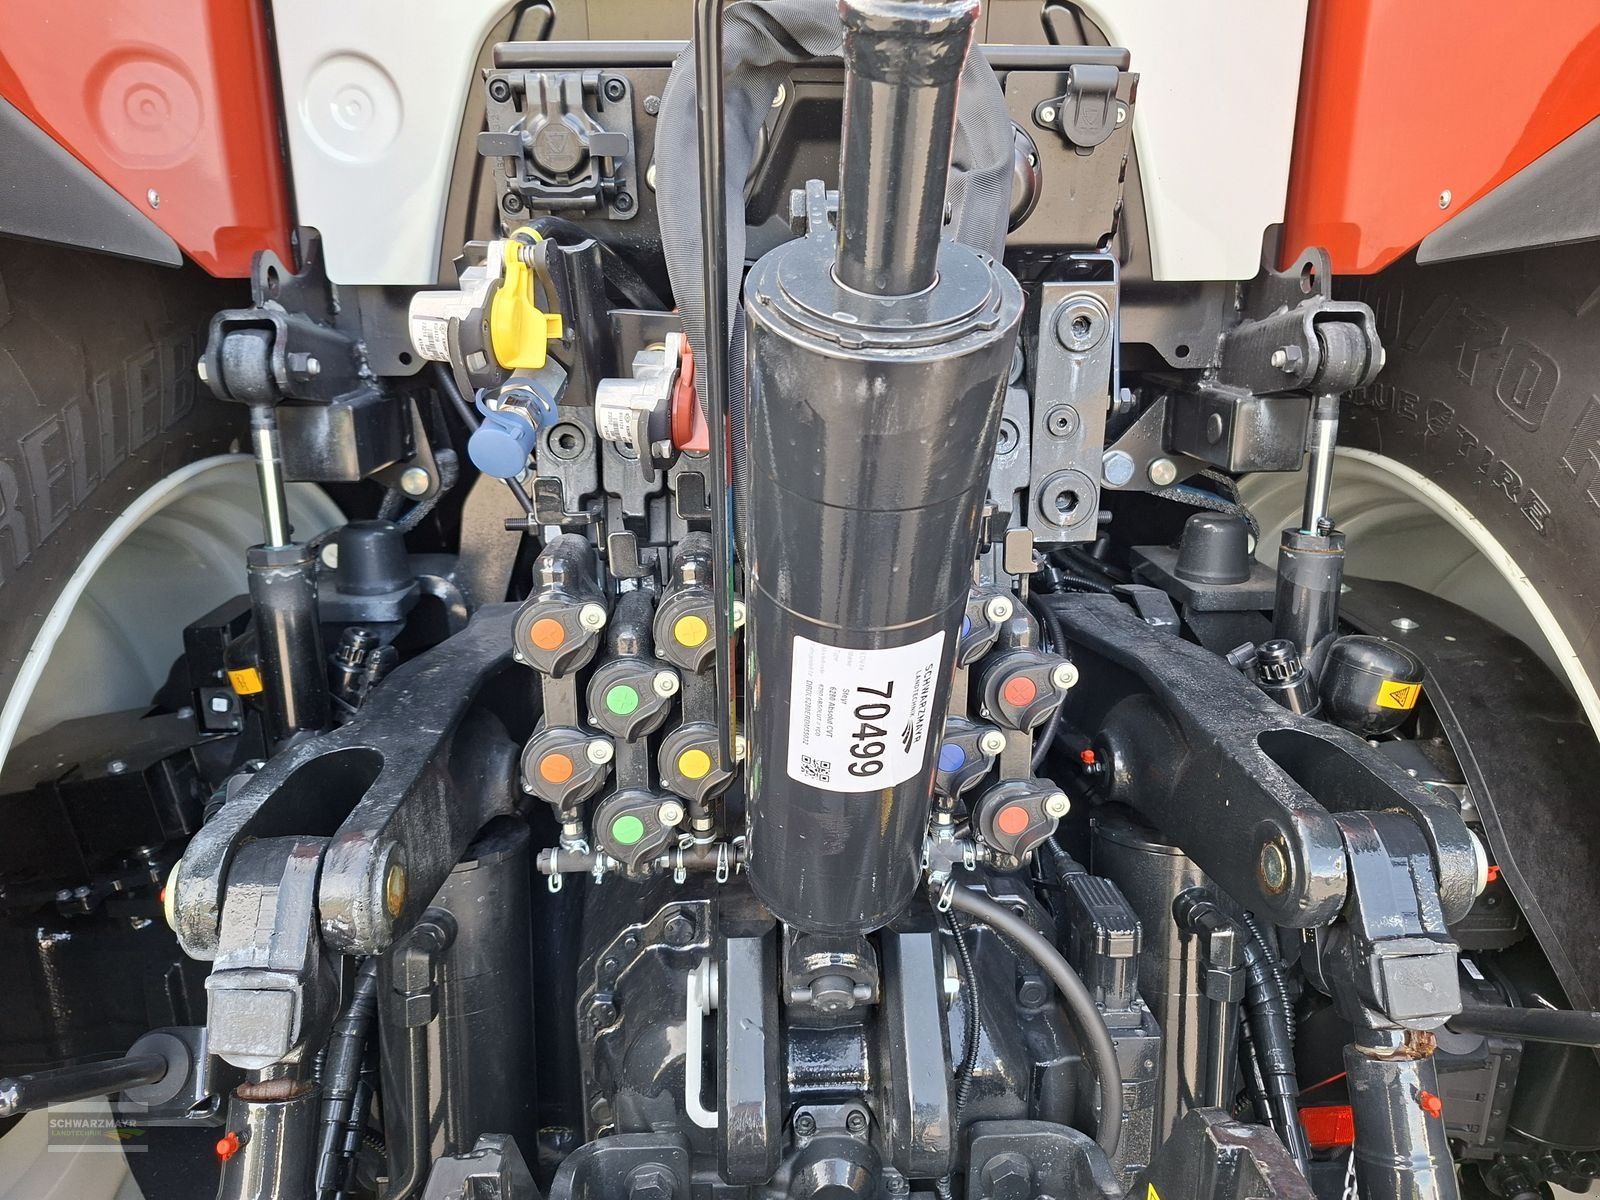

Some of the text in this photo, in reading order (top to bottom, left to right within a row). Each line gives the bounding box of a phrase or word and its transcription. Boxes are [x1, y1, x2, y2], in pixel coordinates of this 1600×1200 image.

[1455, 422, 1552, 534] TIRE
[840, 688, 850, 705] Steyr
[910, 669, 922, 717] LANDTECHNIK
[914, 663, 934, 744] SCHWARZMAYR
[825, 724, 834, 738] CVT
[847, 681, 894, 777] 70499
